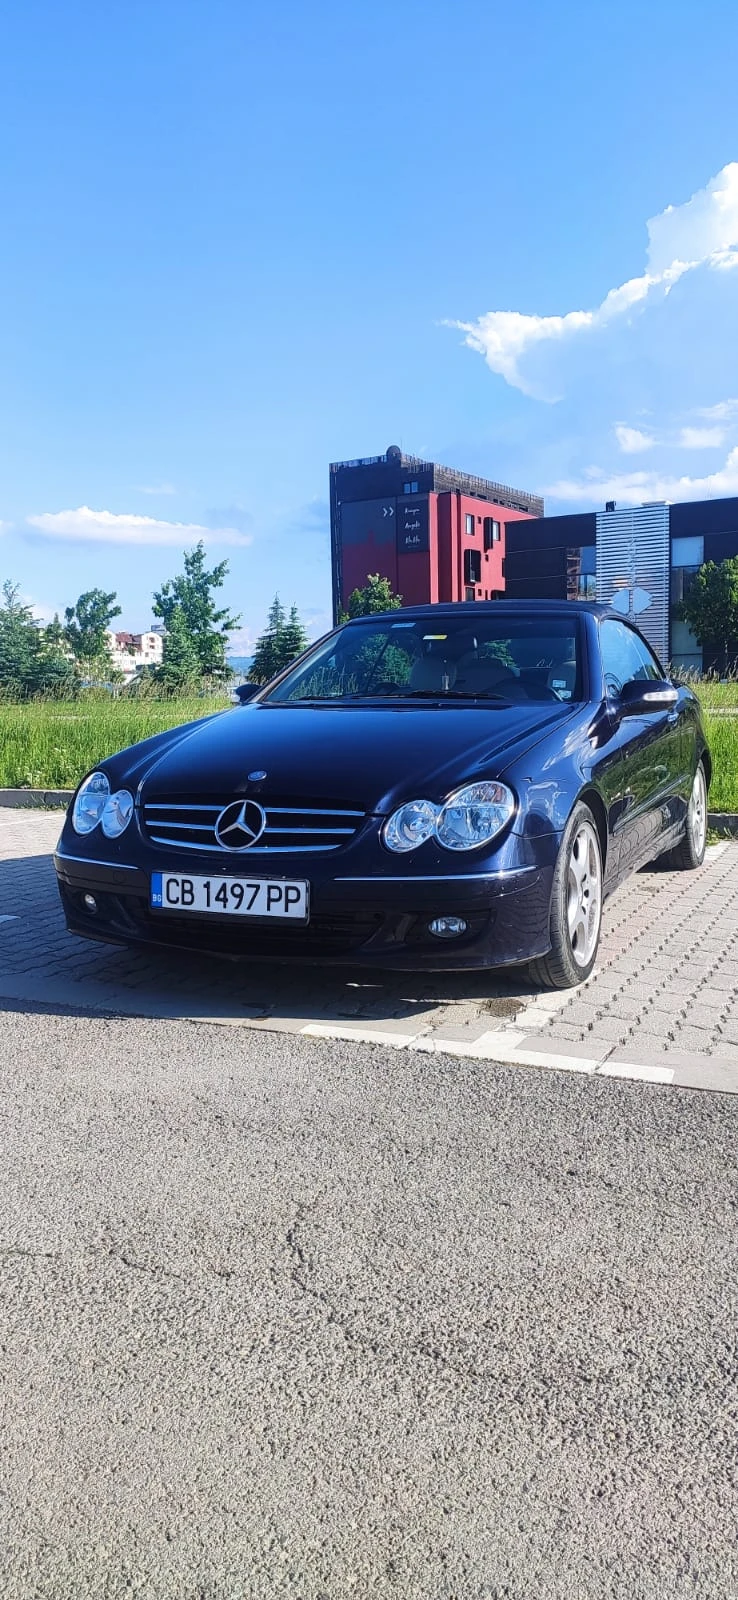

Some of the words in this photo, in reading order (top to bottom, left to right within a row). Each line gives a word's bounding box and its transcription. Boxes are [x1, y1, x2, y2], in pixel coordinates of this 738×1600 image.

[152, 893, 162, 903] BG
[166, 878, 195, 906] CB
[203, 880, 261, 911] 1497
[266, 884, 301, 913] PP
